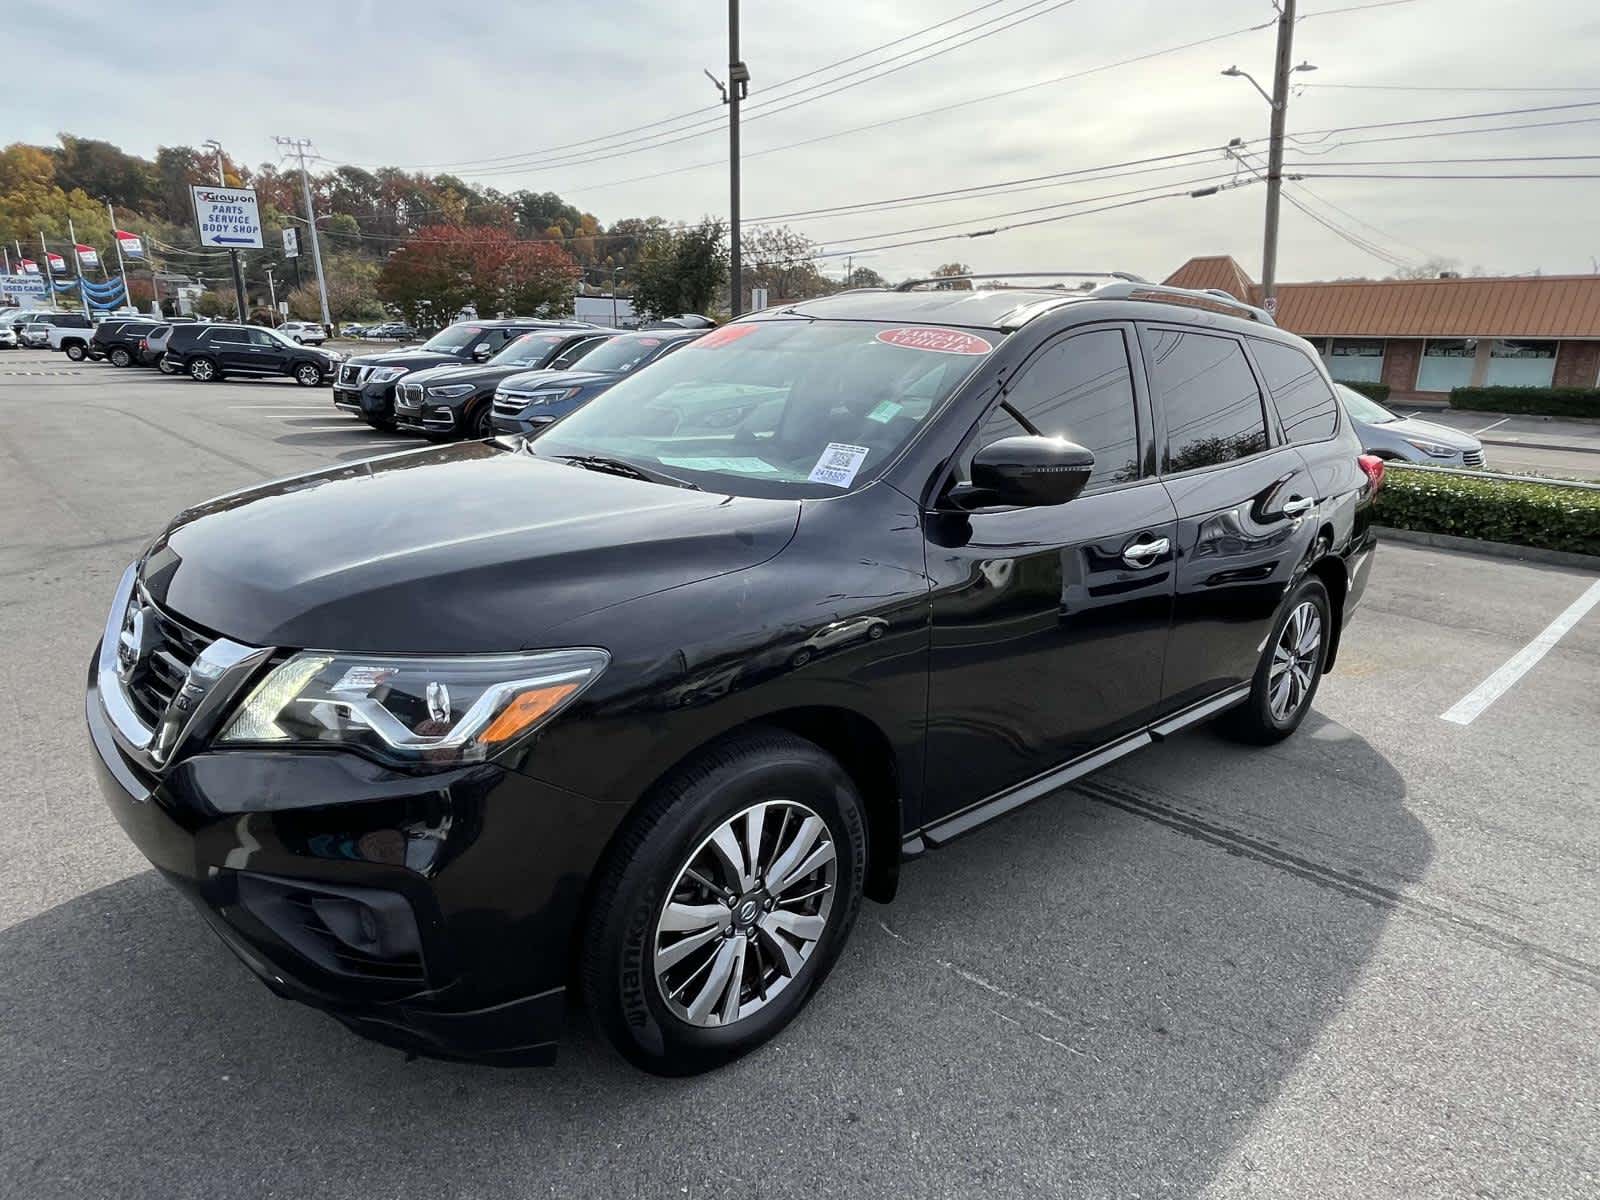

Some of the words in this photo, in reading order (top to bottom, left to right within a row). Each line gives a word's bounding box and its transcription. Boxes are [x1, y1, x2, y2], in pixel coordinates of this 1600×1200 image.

[207, 192, 255, 203] Grayson
[212, 205, 243, 214] PARTS
[208, 214, 250, 224] SERVICE
[202, 223, 229, 233] BODY
[233, 225, 259, 233] SHOP
[891, 335, 970, 353] VEHICLE
